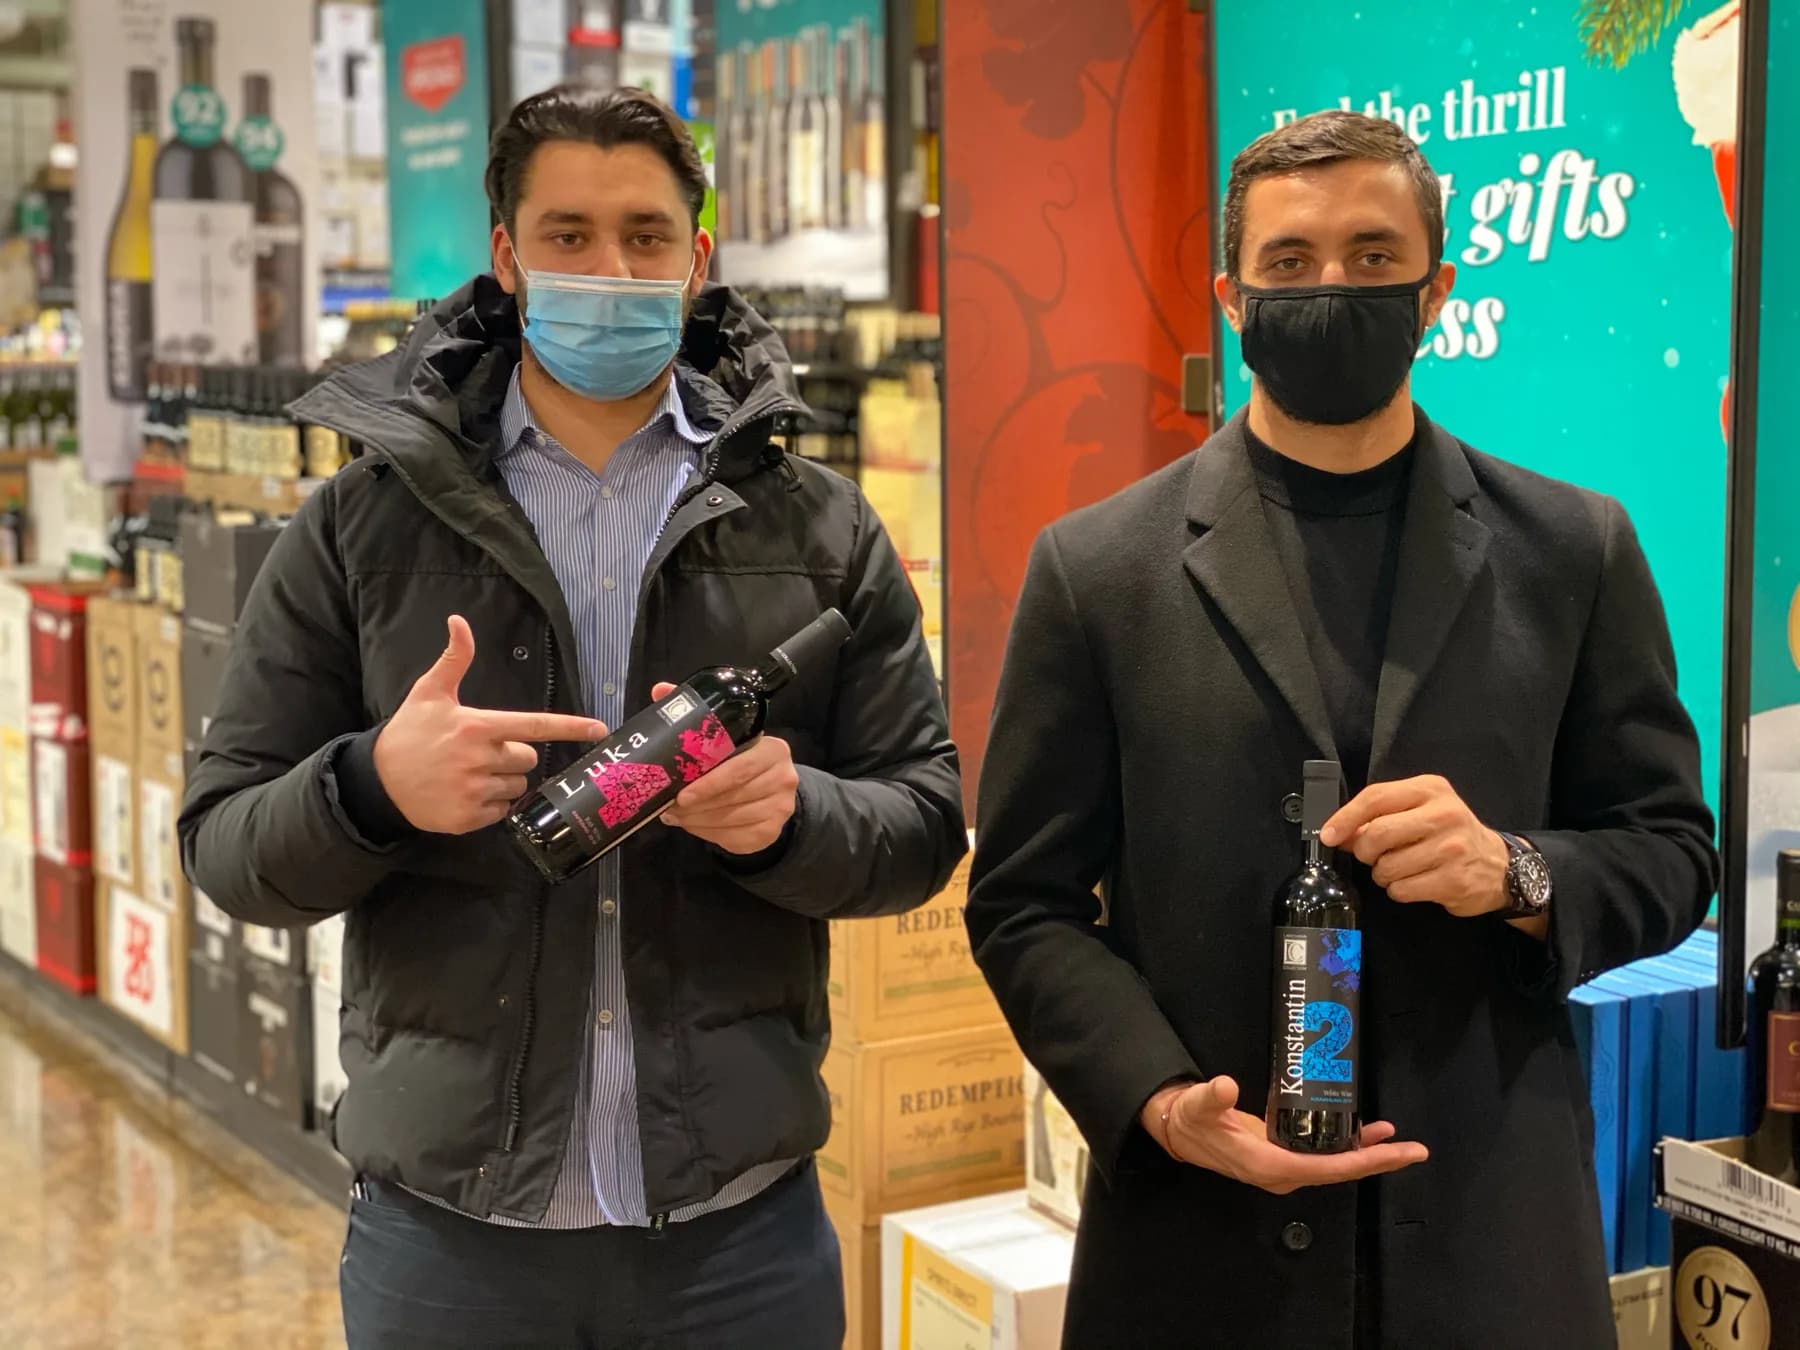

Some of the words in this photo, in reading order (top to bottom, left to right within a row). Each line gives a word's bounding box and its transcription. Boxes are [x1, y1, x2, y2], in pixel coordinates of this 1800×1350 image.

[1441, 65, 1566, 141] thrill
[1461, 149, 1634, 266] gifts
[556, 731, 649, 799] Luka
[1280, 979, 1306, 1097] Konstantin
[1693, 1273, 1752, 1341] 97
